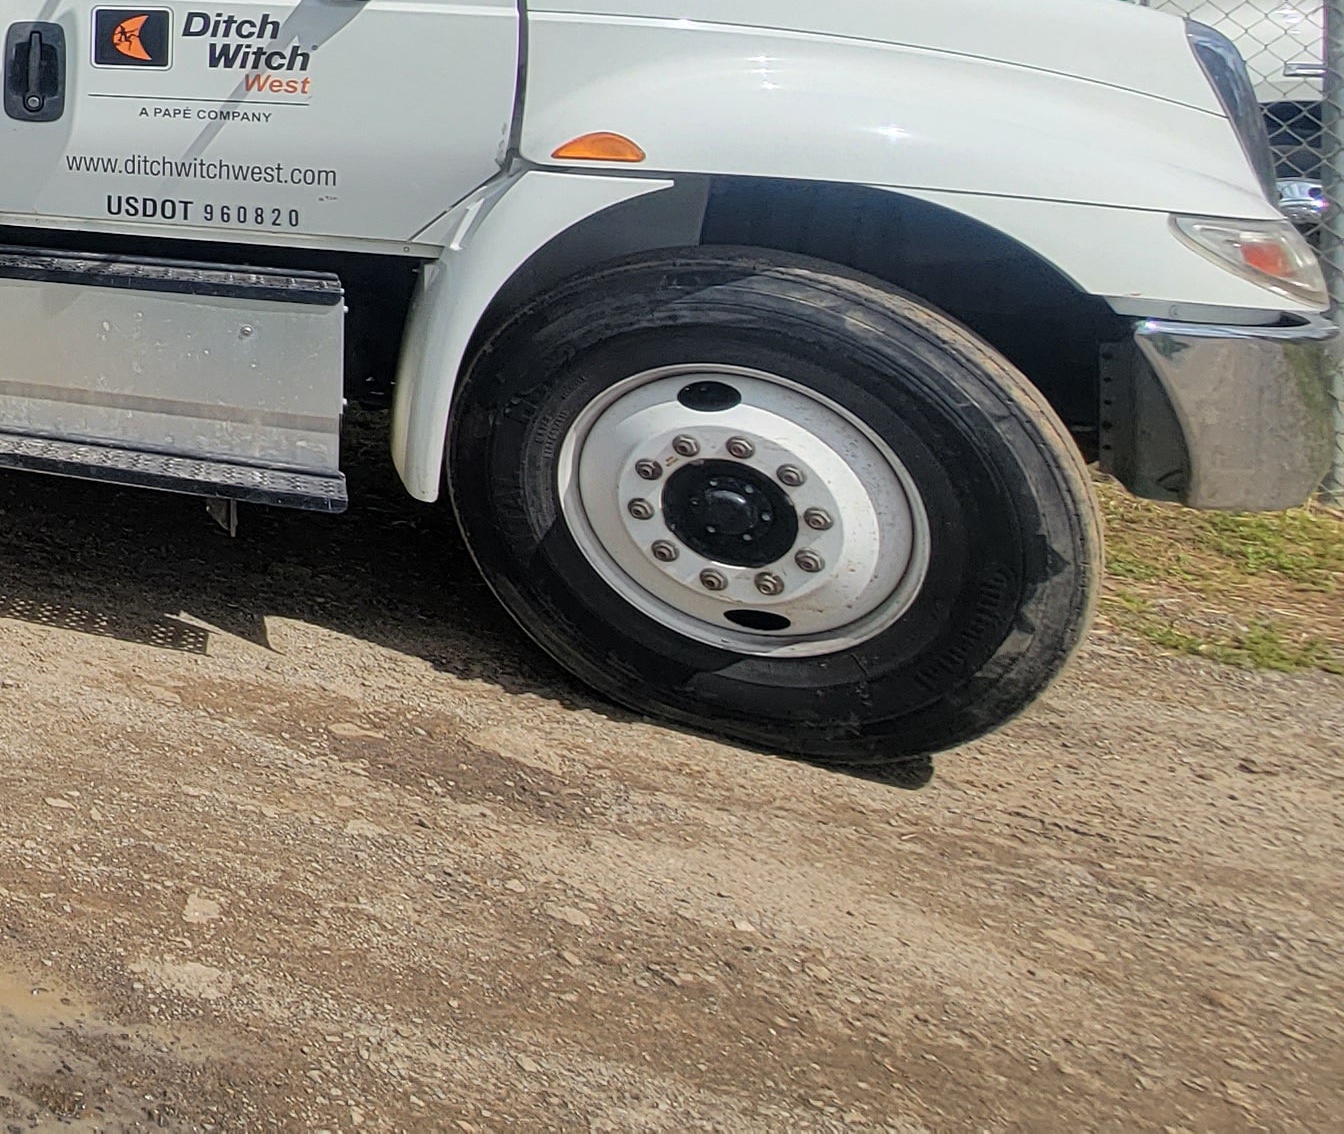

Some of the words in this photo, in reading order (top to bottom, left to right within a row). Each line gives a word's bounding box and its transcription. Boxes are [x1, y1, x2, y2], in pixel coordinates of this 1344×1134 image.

[182, 12, 280, 39] Ditch
[208, 43, 311, 71] Witch
[244, 73, 311, 94] West
[139, 107, 149, 117] A
[196, 109, 272, 123] COMPANY
[66, 155, 337, 187] www.ditchwitchwest.com
[106, 195, 194, 221] USDOT
